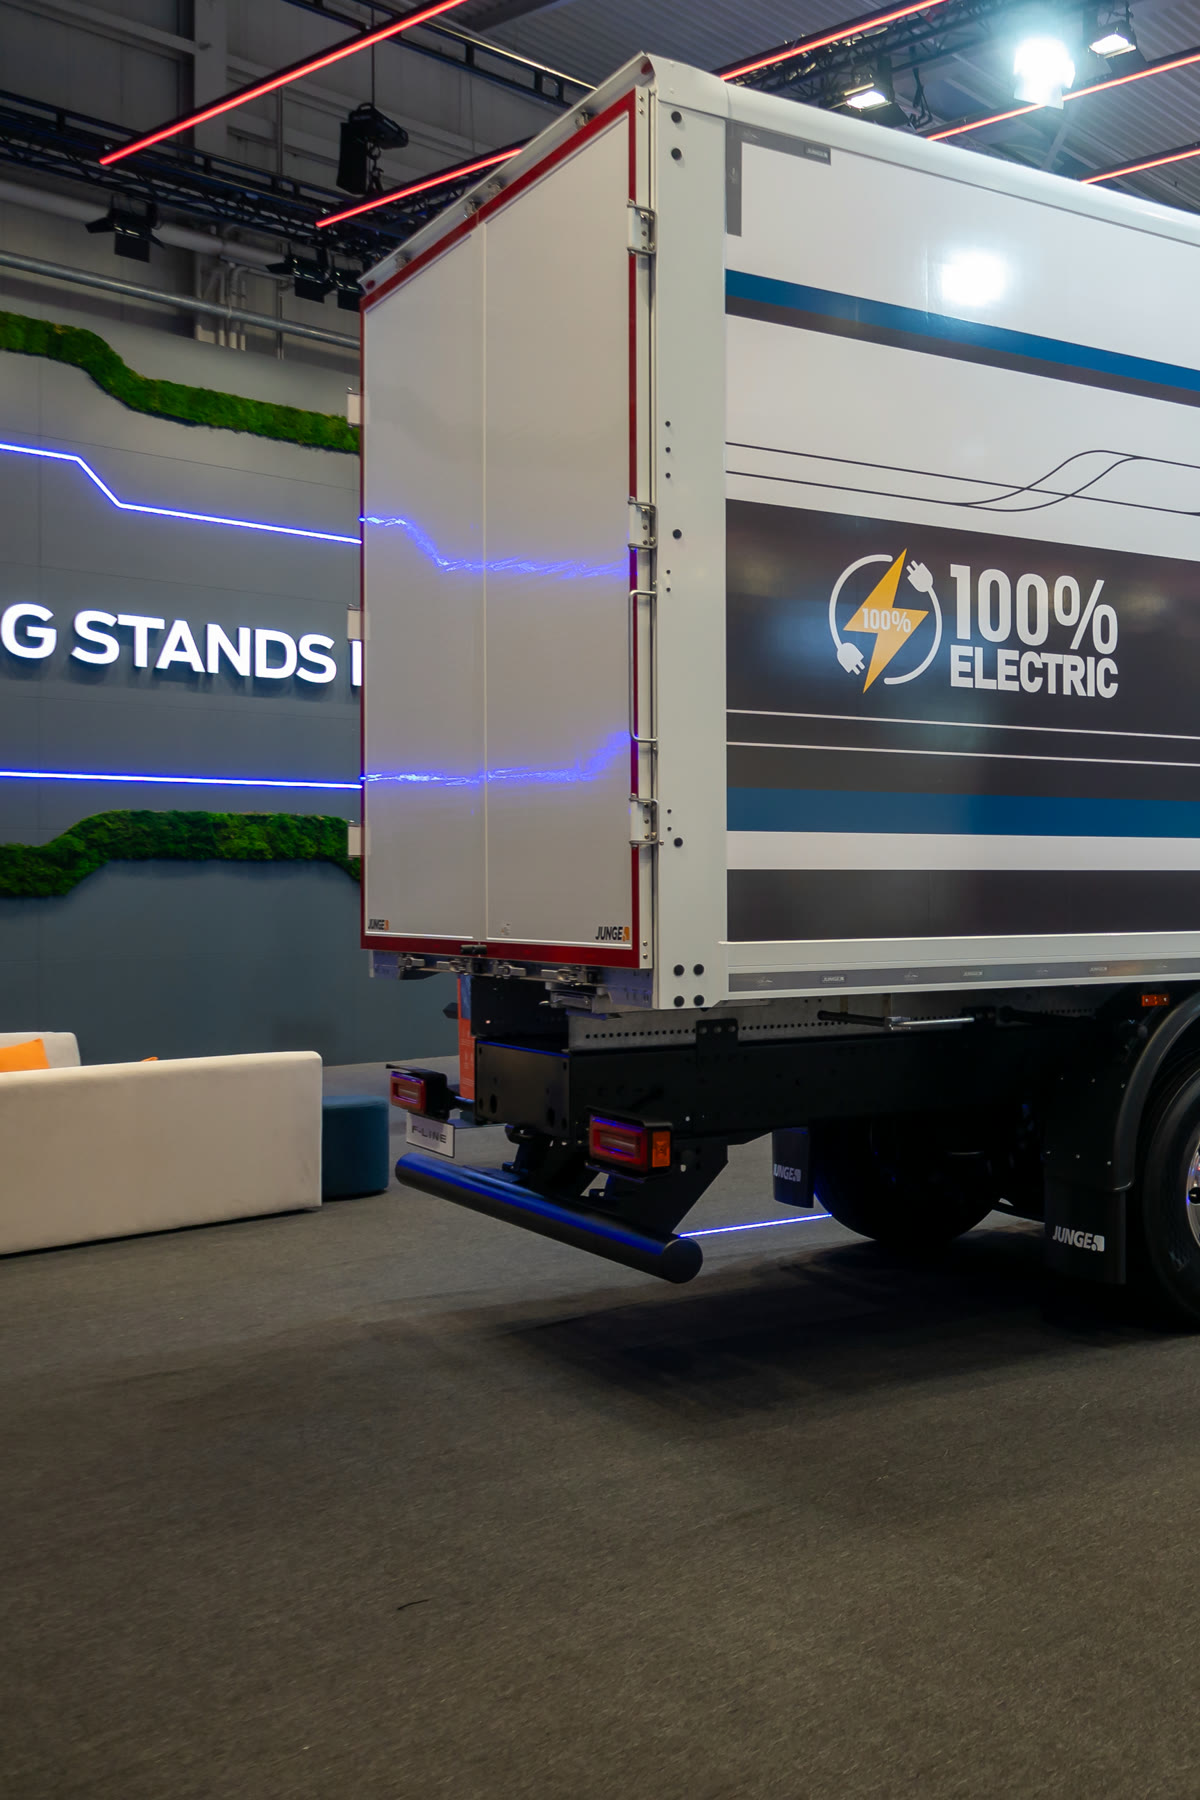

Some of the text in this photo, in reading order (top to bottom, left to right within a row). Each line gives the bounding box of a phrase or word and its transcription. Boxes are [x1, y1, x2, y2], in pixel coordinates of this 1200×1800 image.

[861, 607, 912, 633] 100%
[950, 563, 1119, 655] 100%
[71, 609, 338, 685] STANDS
[950, 644, 1119, 699] ELECTRIC
[595, 926, 623, 941] JUNGE
[411, 1125, 447, 1144] F-LINE
[1052, 1225, 1094, 1249] JUNGE
